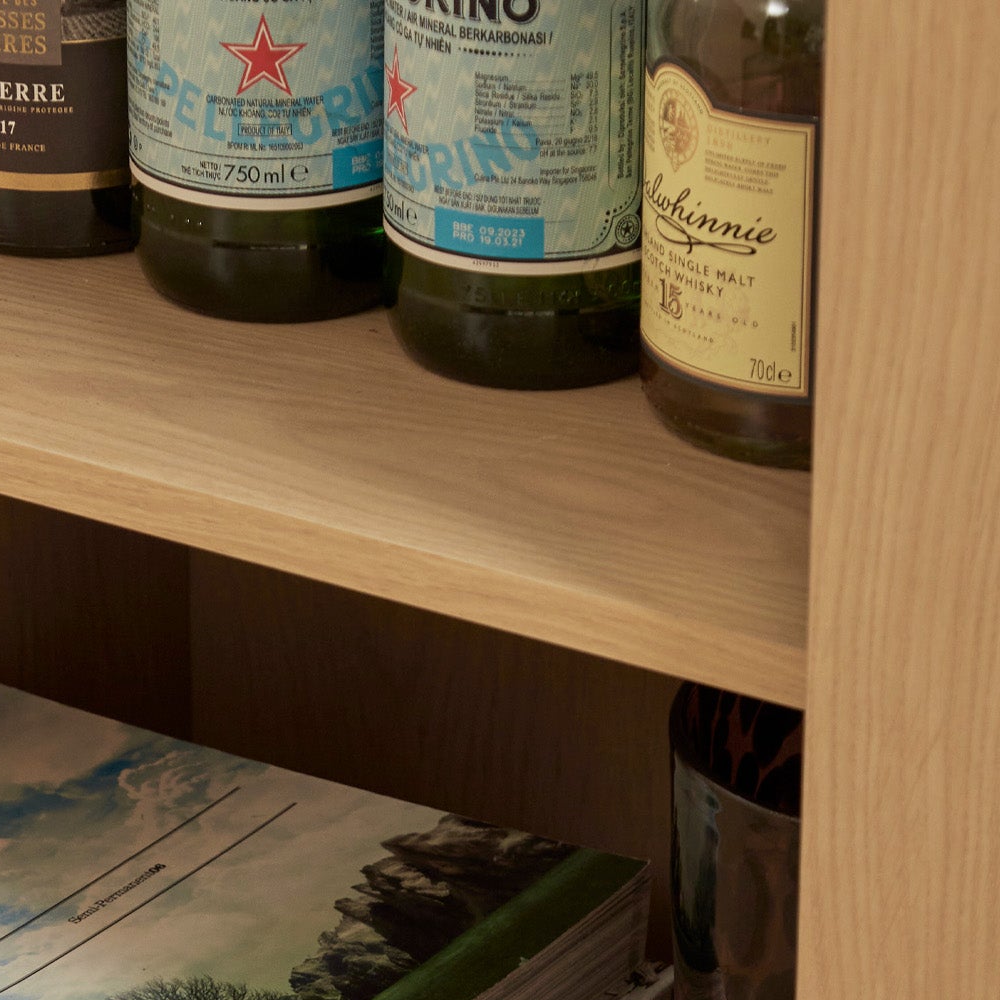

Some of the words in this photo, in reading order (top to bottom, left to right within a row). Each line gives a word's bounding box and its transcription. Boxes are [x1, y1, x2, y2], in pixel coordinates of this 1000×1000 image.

[407, 9, 418, 26] AIR
[419, 14, 457, 38] MINERAL
[459, 25, 546, 46] BERKARBONASI
[546, 31, 553, 44] /
[206, 94, 246, 107] CARBONATED
[246, 97, 274, 107] NATURAL
[275, 97, 302, 107] MINERAL
[303, 95, 324, 105] WATER
[241, 125, 266, 135] PRODUCT
[268, 125, 275, 135] OF
[277, 125, 290, 135] ITALY
[9, 142, 46, 153] FRANCE
[224, 164, 261, 183] 750
[264, 163, 285, 183] ml
[395, 200, 404, 221] ml
[452, 221, 474, 232] BBE
[479, 226, 526, 238] 09.2023
[453, 231, 475, 242] PRO
[668, 250, 709, 276] SINGLE
[717, 269, 755, 288] MALT
[675, 271, 724, 298] WHISKY
[659, 278, 683, 321] 15
[685, 302, 721, 320] YEARS
[732, 316, 759, 328] OLD
[749, 358, 776, 382] 70cl
